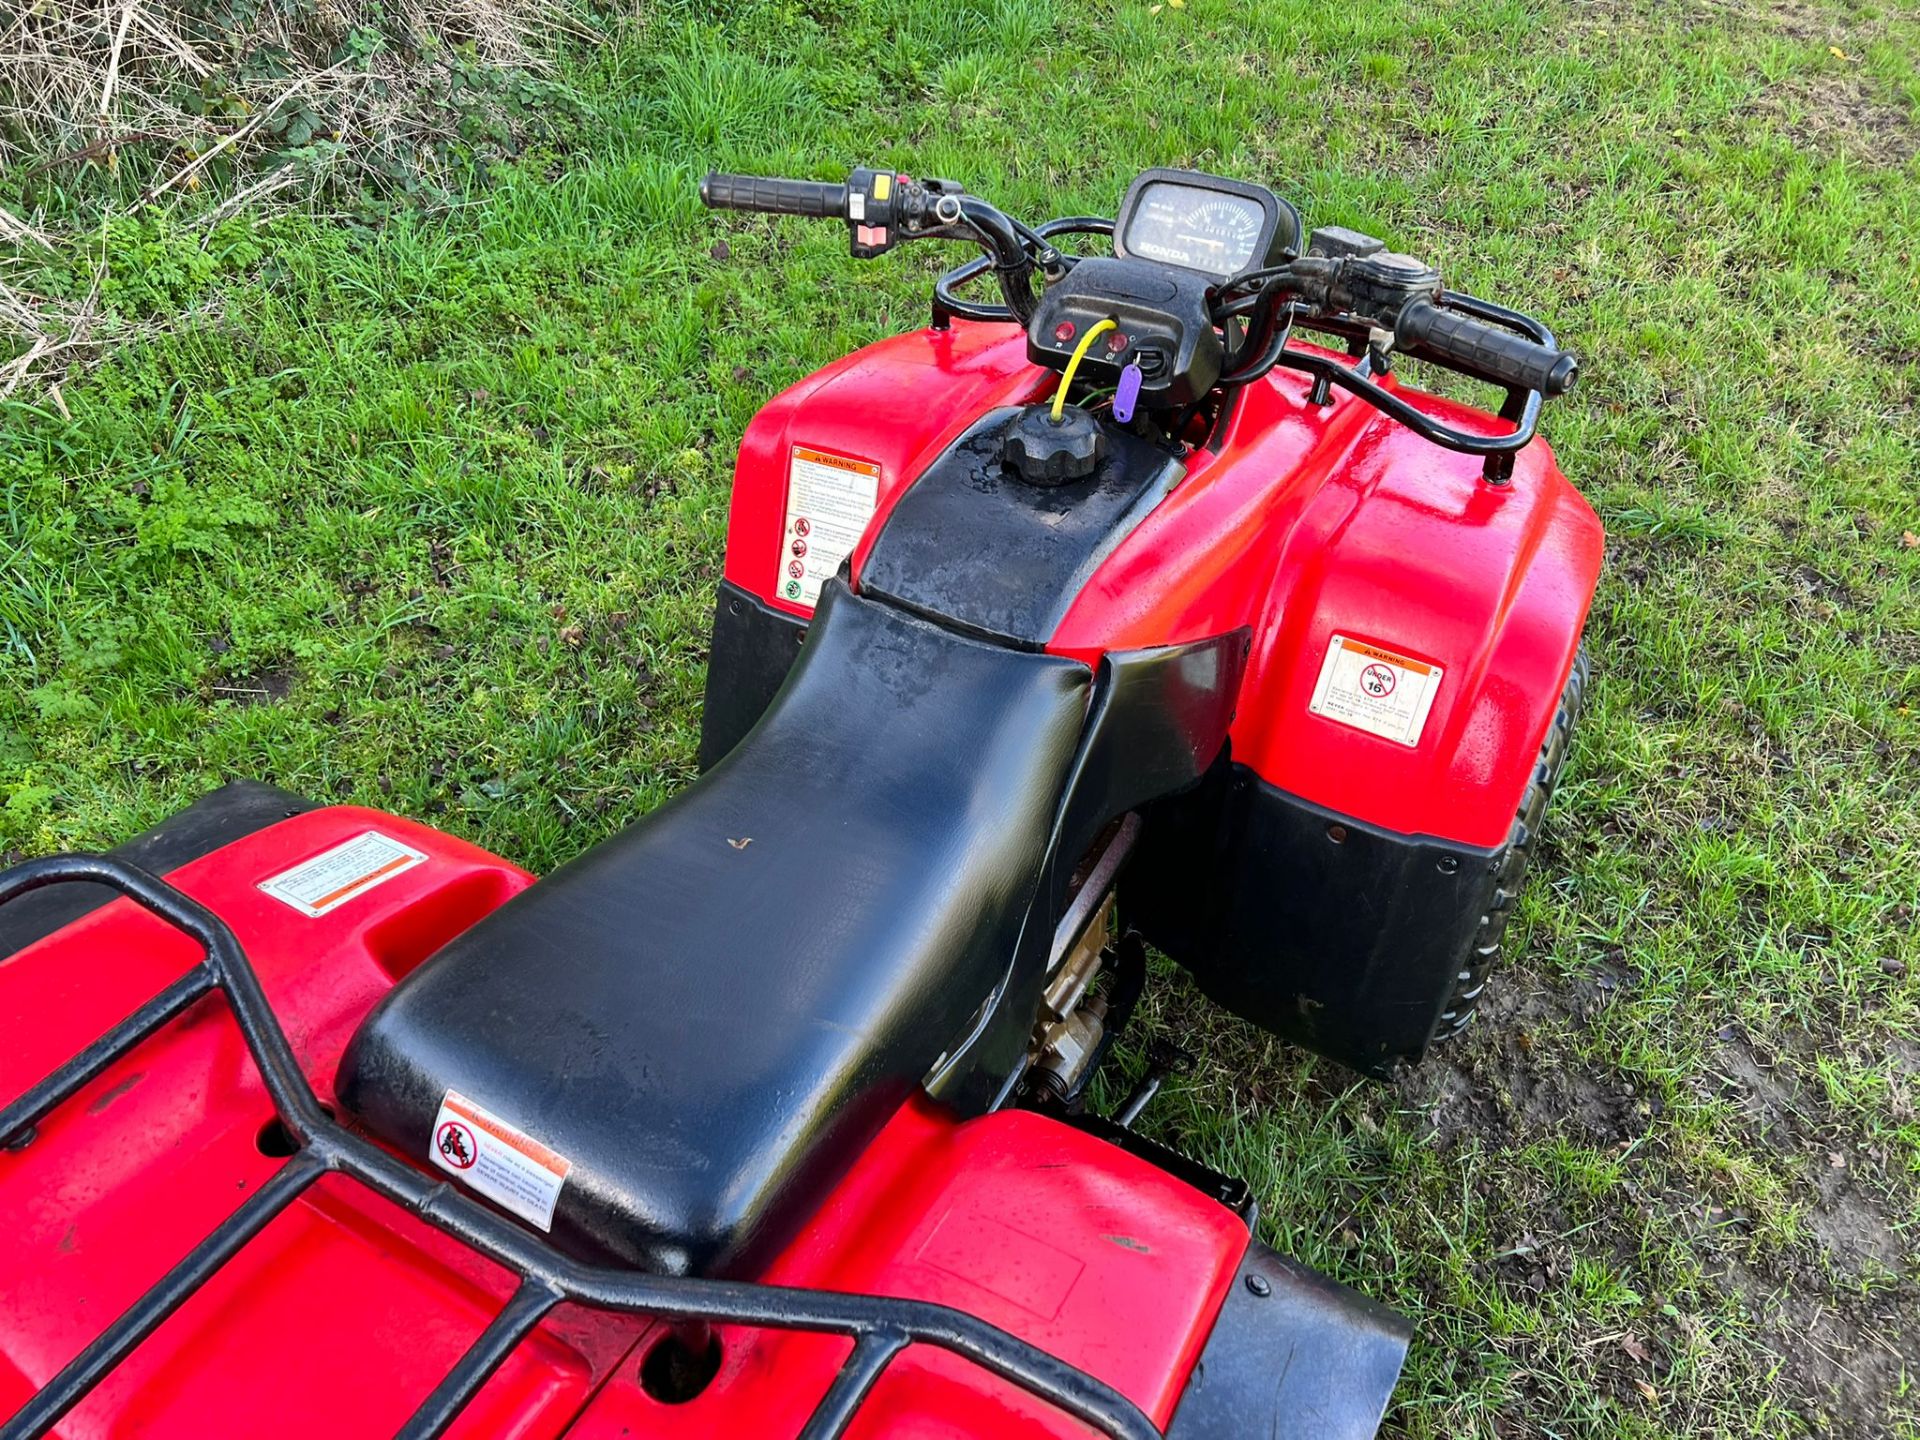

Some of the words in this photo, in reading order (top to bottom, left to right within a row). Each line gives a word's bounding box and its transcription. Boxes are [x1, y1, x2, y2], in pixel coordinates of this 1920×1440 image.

[1139, 242, 1190, 262] HONDA
[822, 457, 857, 471] WARNING
[1373, 652, 1405, 666] WARNING
[1367, 669, 1392, 683] UNDER
[1368, 682, 1382, 693] 16
